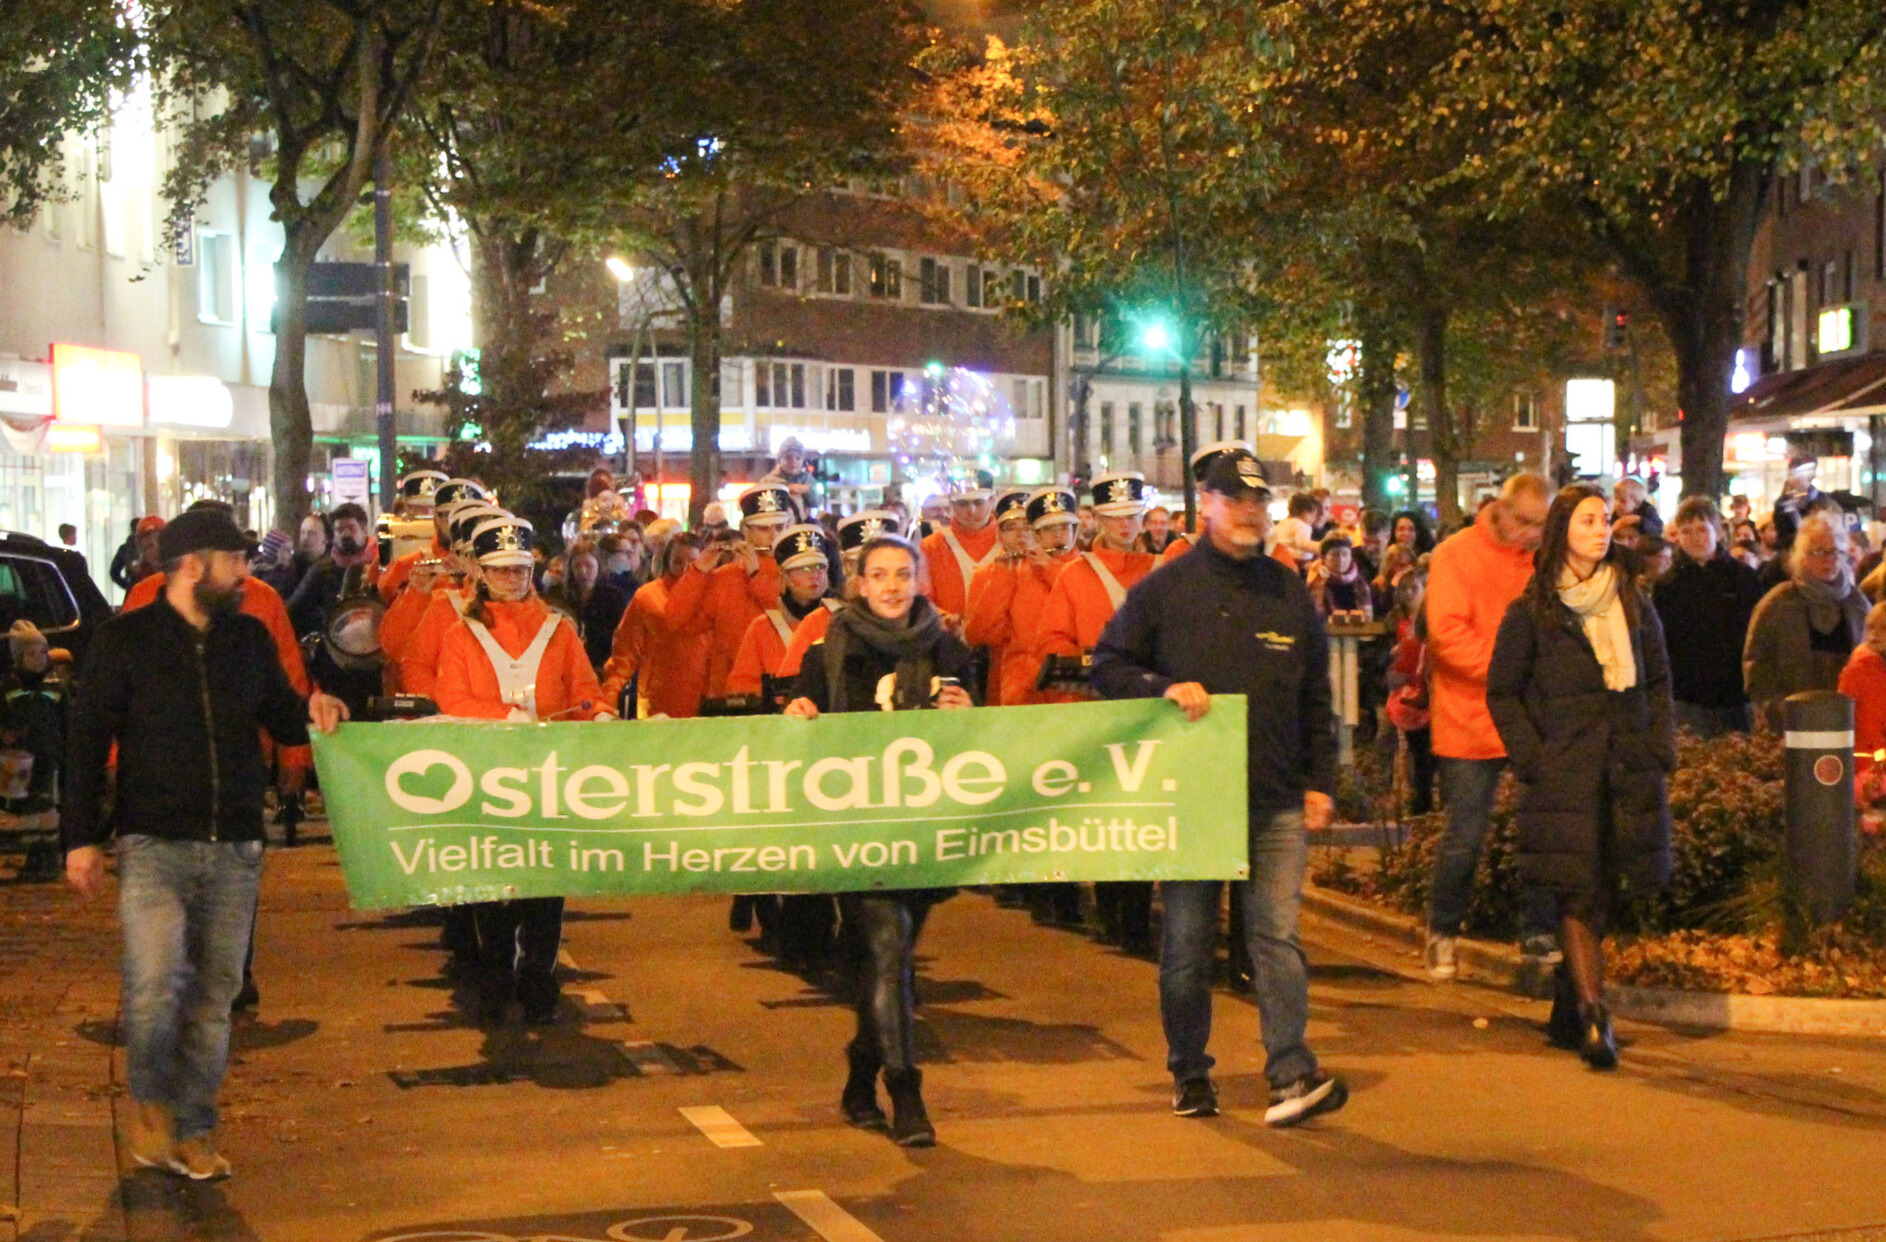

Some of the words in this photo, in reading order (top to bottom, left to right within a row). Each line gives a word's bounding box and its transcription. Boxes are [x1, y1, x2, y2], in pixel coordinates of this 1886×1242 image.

[385, 737, 1007, 820] Osterstraße
[389, 836, 555, 875] Vielfalt
[570, 841, 625, 872] im
[642, 841, 817, 873] Herzen
[832, 838, 918, 869] von
[935, 816, 1178, 862] Eimsbüttel
